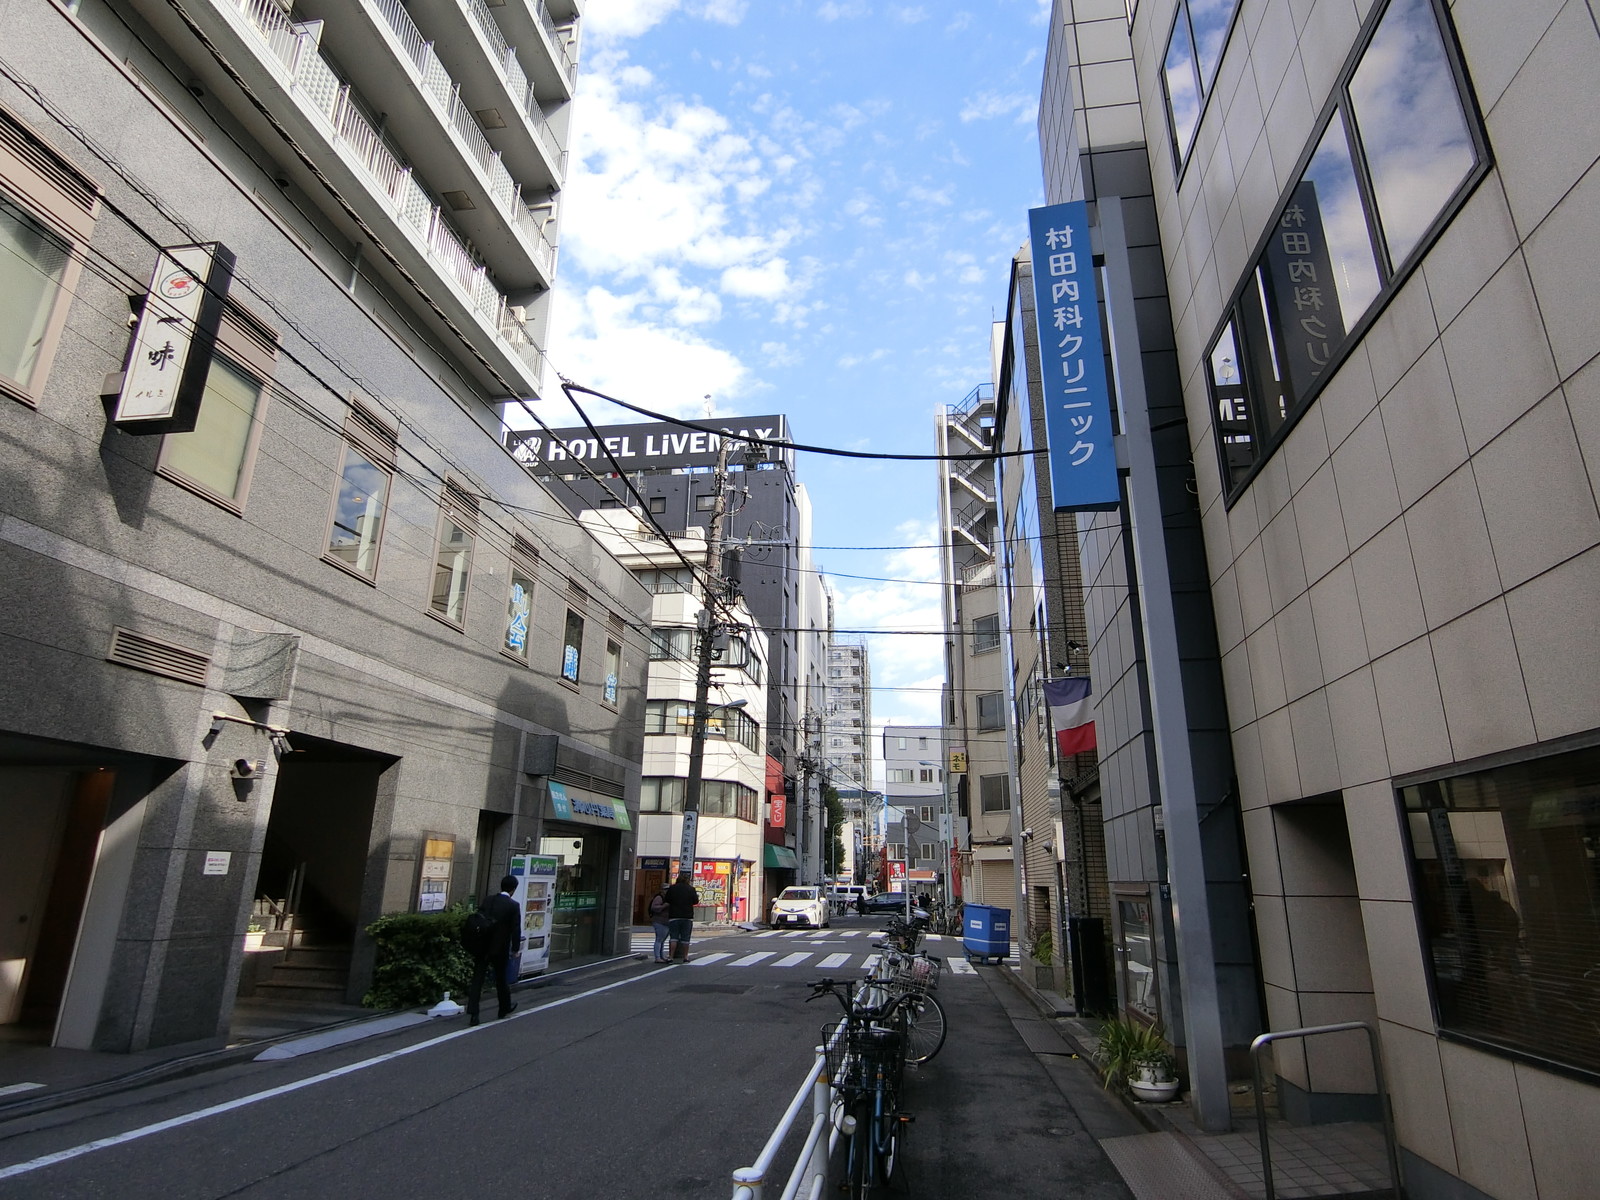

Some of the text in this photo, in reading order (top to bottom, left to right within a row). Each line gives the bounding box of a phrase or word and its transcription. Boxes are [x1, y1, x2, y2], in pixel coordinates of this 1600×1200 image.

[148, 316, 183, 371] 一味
[1045, 225, 1094, 467] 村田内科クリニック
[548, 436, 636, 461] HOTEL
[774, 800, 783, 823] 宝くじ
